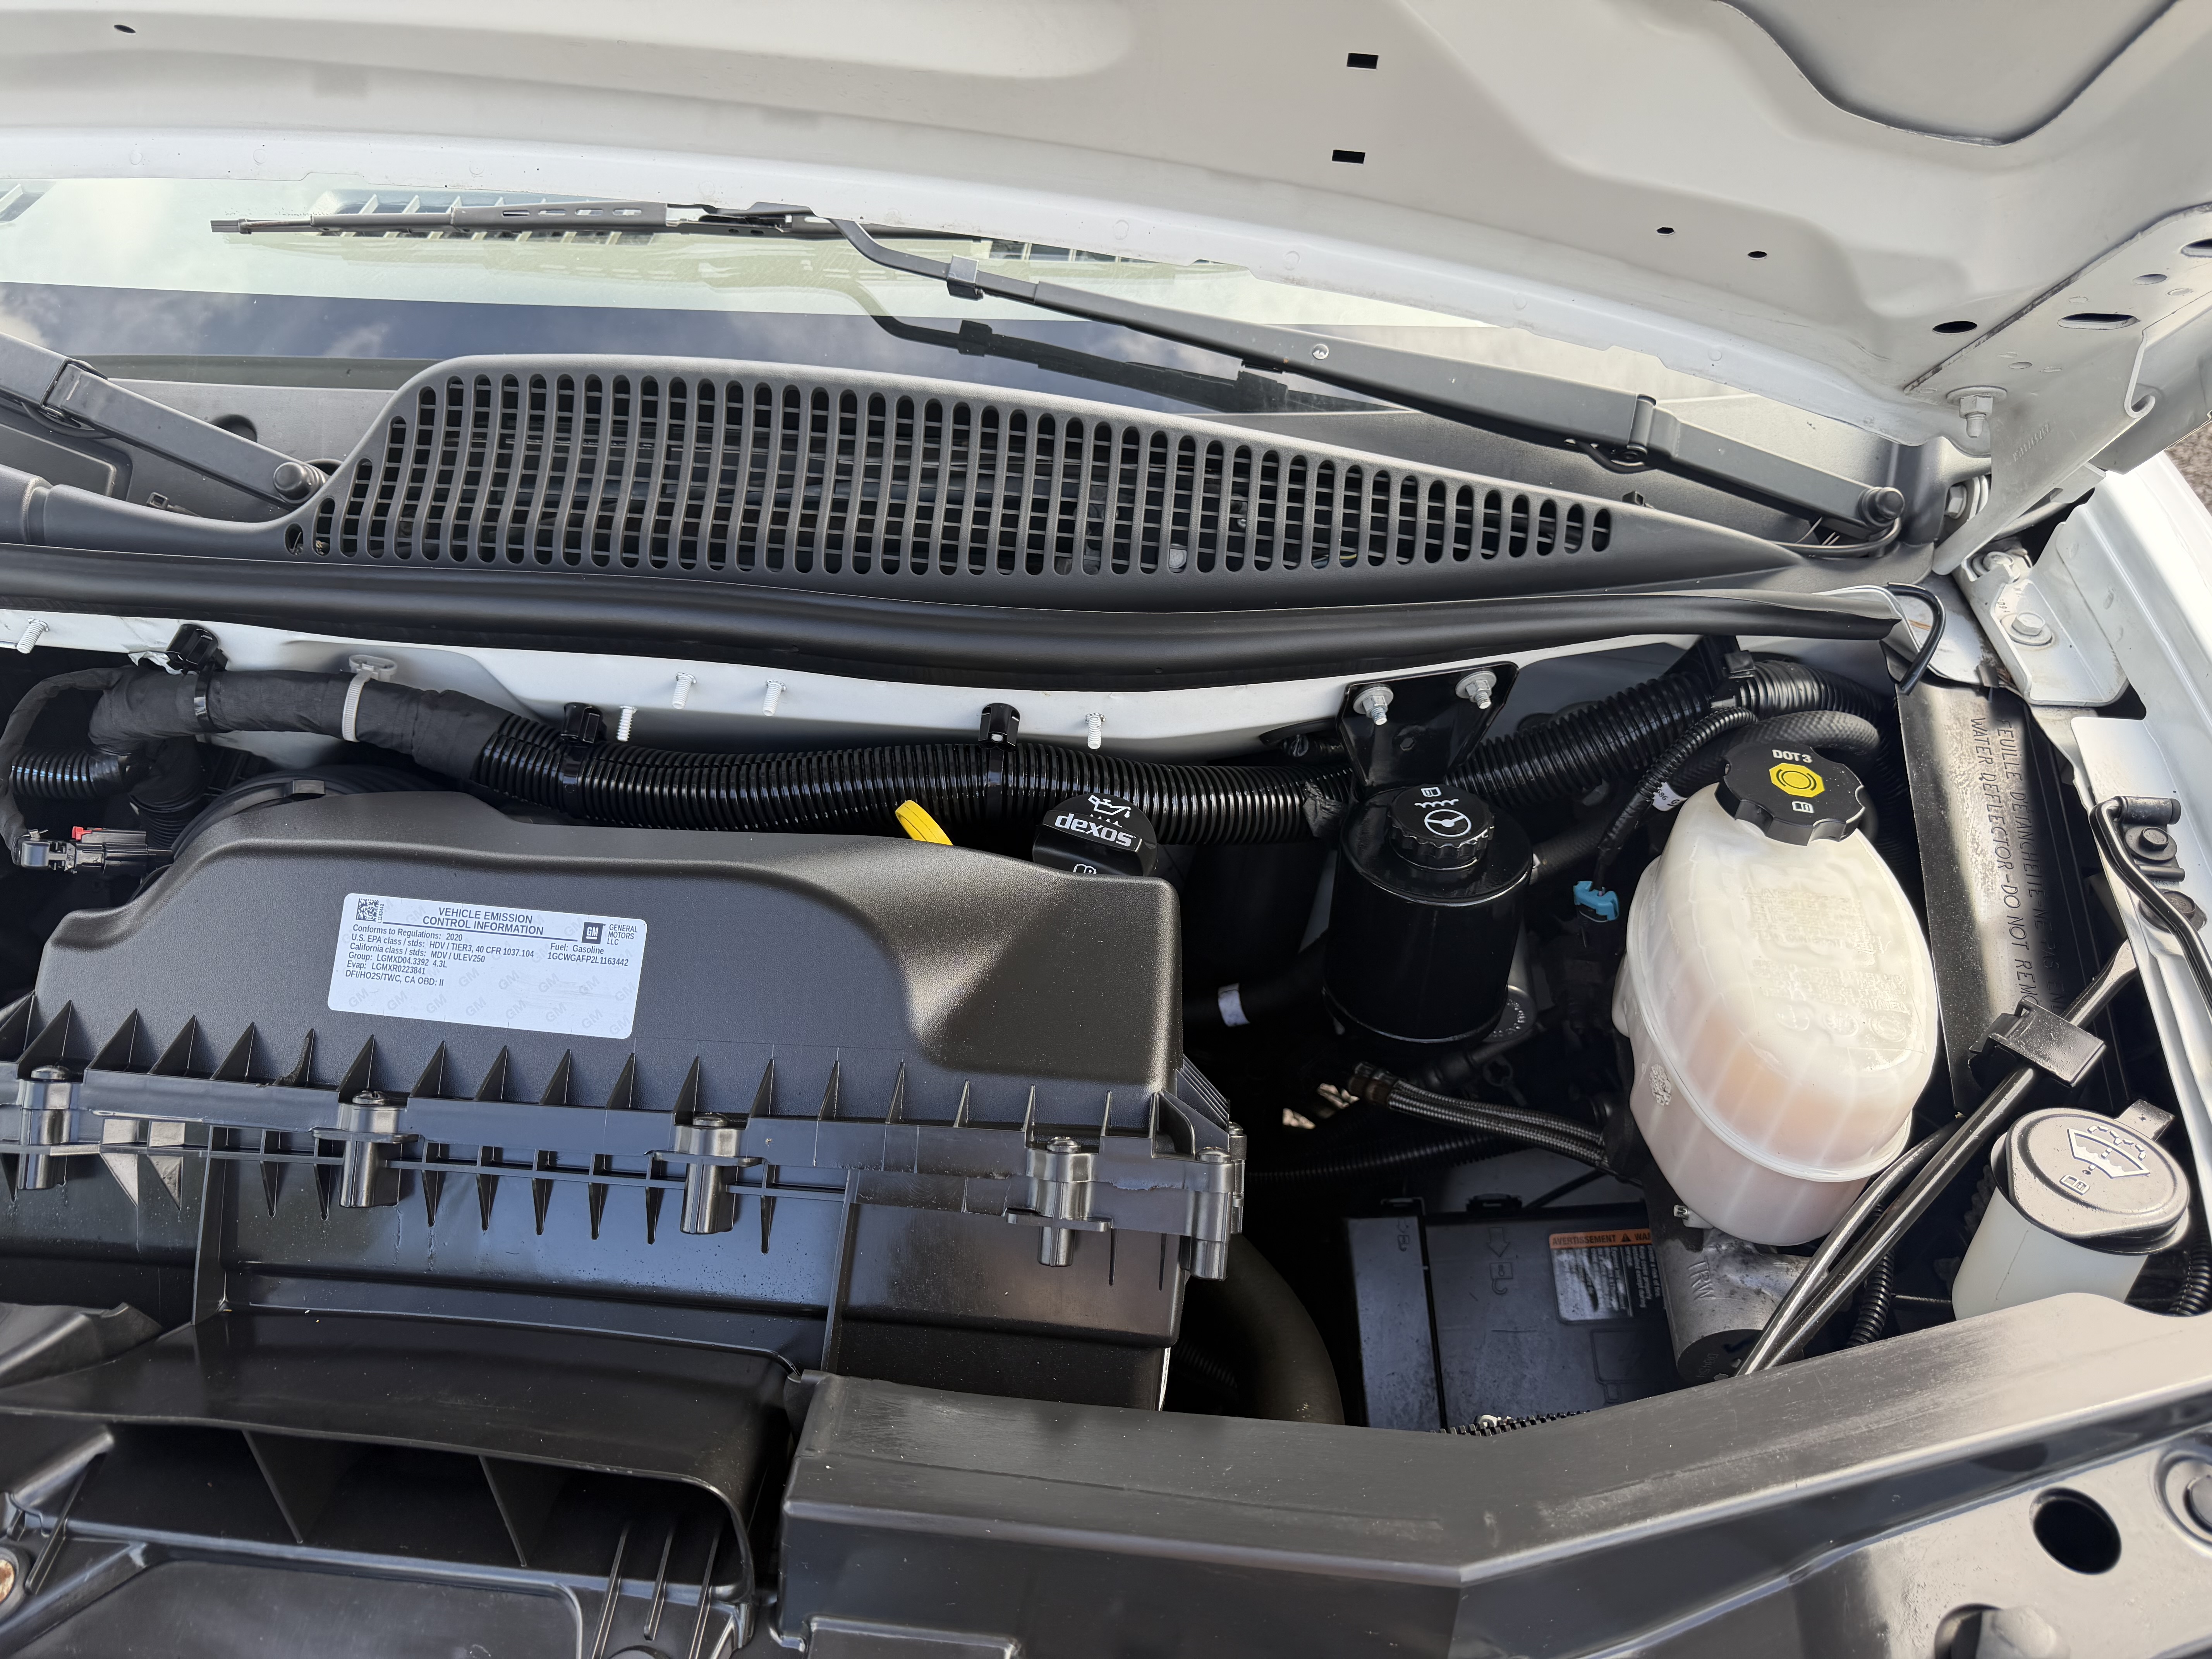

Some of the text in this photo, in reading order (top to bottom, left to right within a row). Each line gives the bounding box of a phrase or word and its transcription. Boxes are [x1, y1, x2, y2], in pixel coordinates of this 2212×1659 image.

[1772, 749, 1813, 763] DOT 3
[1054, 813, 1133, 847] dexos
[1970, 718, 1994, 764] WATER
[2006, 915, 2030, 950] NOT
[1996, 719, 2023, 781] FEUILLE
[2040, 940, 2059, 968] PAS
[422, 916, 544, 935] CONTROL INFORMATION
[439, 907, 532, 924] VEHICLE EMISSION
[353, 924, 387, 934] Conforms
[397, 928, 441, 939] Regulations:
[446, 933, 463, 941] 2020
[586, 926, 599, 937] GM
[608, 931, 635, 940] MOTORS
[609, 924, 638, 933] GENERAL
[350, 942, 383, 953] California
[385, 946, 403, 955] class
[409, 948, 426, 957] stds:
[430, 950, 448, 959] MDV
[453, 953, 485, 963] ULEV250
[351, 933, 365, 942] U.S.
[367, 935, 381, 943] EPA
[383, 937, 402, 945] class
[407, 939, 425, 948] stds:
[429, 941, 445, 949] HDV
[452, 943, 474, 953] TIER3,
[476, 945, 484, 953] 40
[486, 946, 501, 955] CFR
[503, 948, 534, 958] 1037.104
[550, 942, 604, 954] Fuel: Gasoline
[347, 960, 426, 975] Evap: LGMXR0223841
[348, 951, 448, 968] Group: LGMXD04.3392 4.3L
[547, 952, 629, 967] 1GCWGAFP2L1163442
[345, 969, 444, 987] DFI/HO2S/TWC, CA OBD: II
[458, 968, 480, 988] GM
[498, 970, 521, 991] GM
[538, 972, 560, 993] GM
[579, 975, 600, 996] GM
[348, 988, 370, 1008] GM
[386, 991, 408, 1011] GM
[615, 982, 636, 1002] GM
[426, 994, 447, 1015] GM
[465, 997, 487, 1017] GM
[505, 999, 527, 1019] GM
[544, 1002, 567, 1022] GM
[580, 1008, 603, 1029] GM
[609, 1015, 631, 1036] GM
[1552, 1234, 1616, 1246] AVERTISSEMENT
[1686, 1255, 1716, 1300] TRW
